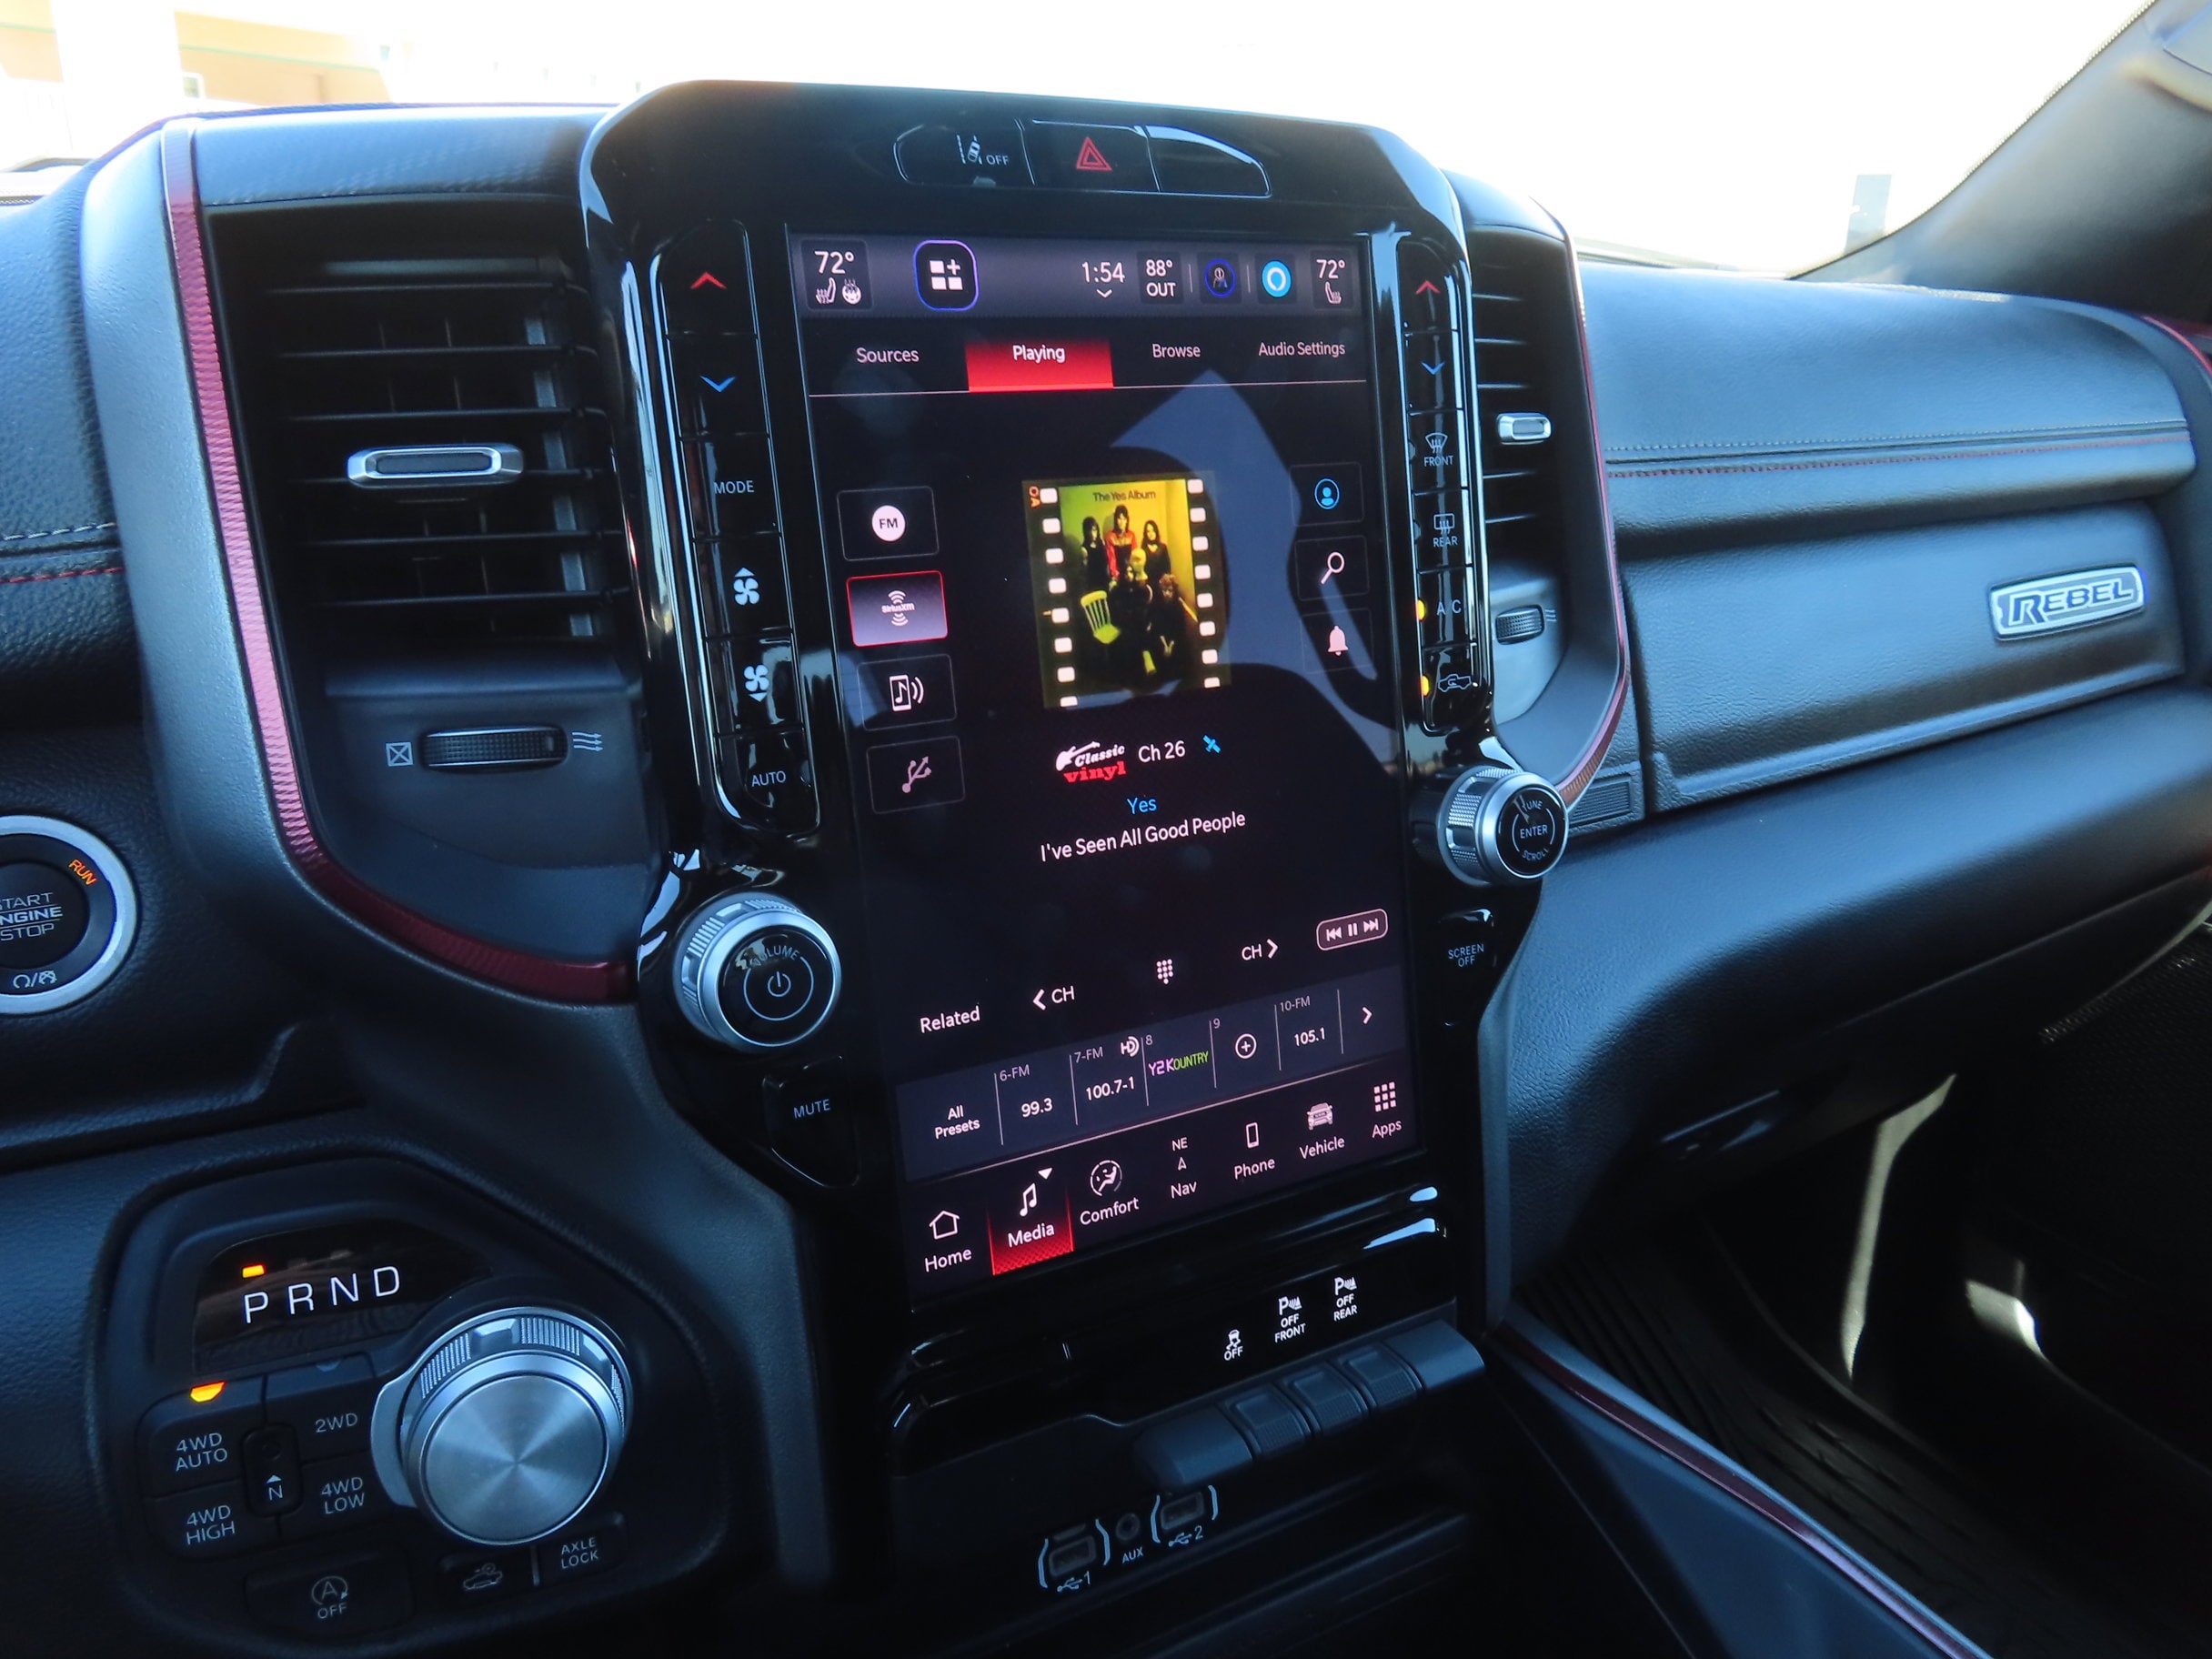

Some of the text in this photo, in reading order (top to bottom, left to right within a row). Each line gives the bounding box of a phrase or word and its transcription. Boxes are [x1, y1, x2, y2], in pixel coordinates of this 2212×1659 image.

[986, 154, 1010, 166] OFF
[1081, 261, 1126, 284] 1:54
[1146, 282, 1176, 297] OUT
[856, 347, 920, 363] Sources
[1012, 344, 1065, 364] Playing
[1151, 342, 1201, 358] Browse
[1258, 339, 1345, 359] Audio Settings
[1423, 455, 1453, 467] FRONT
[713, 479, 755, 495] MODE
[1092, 489, 1156, 502] The Yes Album
[879, 517, 899, 529] FM
[1433, 536, 1458, 548] REAR
[2007, 578, 2135, 627] REBEL
[1138, 740, 1186, 762] Ch 26
[750, 771, 787, 788] AUTO
[1063, 760, 1127, 783] vinyl
[1126, 797, 1158, 815] Yes
[1041, 811, 1246, 861] I've Seen All Good People
[1520, 824, 1548, 839] ENTER
[68, 859, 97, 886] RUN
[0, 892, 54, 910] TART
[0, 906, 64, 926] NGINE
[0, 922, 55, 941] STOP
[1242, 943, 1262, 961] CH
[1448, 943, 1484, 960] SCREEN
[1457, 957, 1475, 968] OFF
[1051, 985, 1075, 1003] CH
[1280, 995, 1311, 1012] 10-FM
[920, 1005, 980, 1033] Related
[1212, 1018, 1221, 1029] 9
[1145, 1034, 1153, 1045] 8
[1294, 1027, 1326, 1046] 105.1
[1074, 1046, 1104, 1063] 7-FM
[1000, 1064, 1031, 1081] 6-FM
[1085, 1076, 1135, 1101] 100.7-1
[793, 1099, 830, 1119] MUTE
[947, 1104, 964, 1121] All
[1021, 1098, 1053, 1117] 99.3
[934, 1119, 980, 1139] Presets
[1372, 1120, 1403, 1139] Apps
[1171, 1137, 1189, 1151] NE
[1299, 1136, 1346, 1160] Vehicle
[1233, 1157, 1276, 1180] Phone
[1171, 1181, 1197, 1199] Nav
[1080, 1197, 1140, 1225] Comfort
[1007, 1222, 1055, 1248] Media
[924, 1248, 972, 1272] Home
[243, 1265, 400, 1323] P R N D
[1335, 1292, 1354, 1309] OFF
[1280, 1312, 1300, 1328] OFF
[1333, 1304, 1358, 1322] REAR
[1274, 1323, 1306, 1343] FRONT
[1223, 1345, 1243, 1361] OFF
[315, 1413, 358, 1433] 2WD
[176, 1433, 223, 1453] 4WD
[176, 1447, 227, 1472] AUTO
[267, 1484, 284, 1500] N
[321, 1476, 364, 1497] 4WD
[324, 1492, 365, 1514] LOW
[186, 1504, 231, 1527] 4WD
[186, 1521, 236, 1545] HIGH
[1194, 1524, 1203, 1540] 2
[560, 1536, 597, 1555] AXLE
[561, 1550, 599, 1570] LOCK
[1121, 1546, 1144, 1564] AUX
[1083, 1571, 1091, 1585] 1
[317, 1603, 347, 1620] OFF
